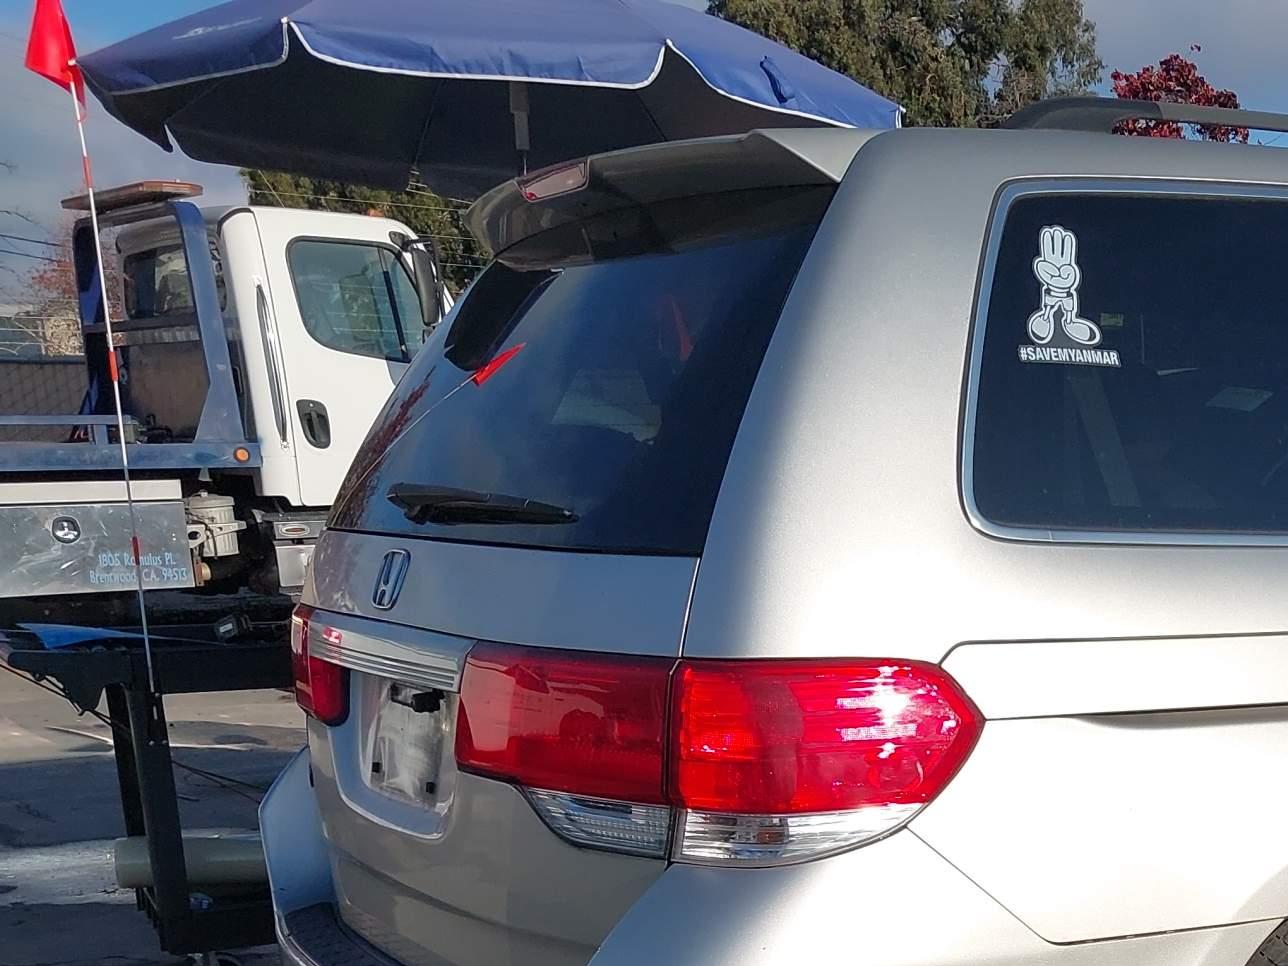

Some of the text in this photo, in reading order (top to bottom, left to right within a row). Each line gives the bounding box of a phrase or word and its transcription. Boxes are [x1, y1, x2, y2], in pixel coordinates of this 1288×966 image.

[1019, 347, 1119, 366] #SAVEMYANMAR
[98, 552, 121, 567] 1805
[162, 567, 188, 581] 94513
